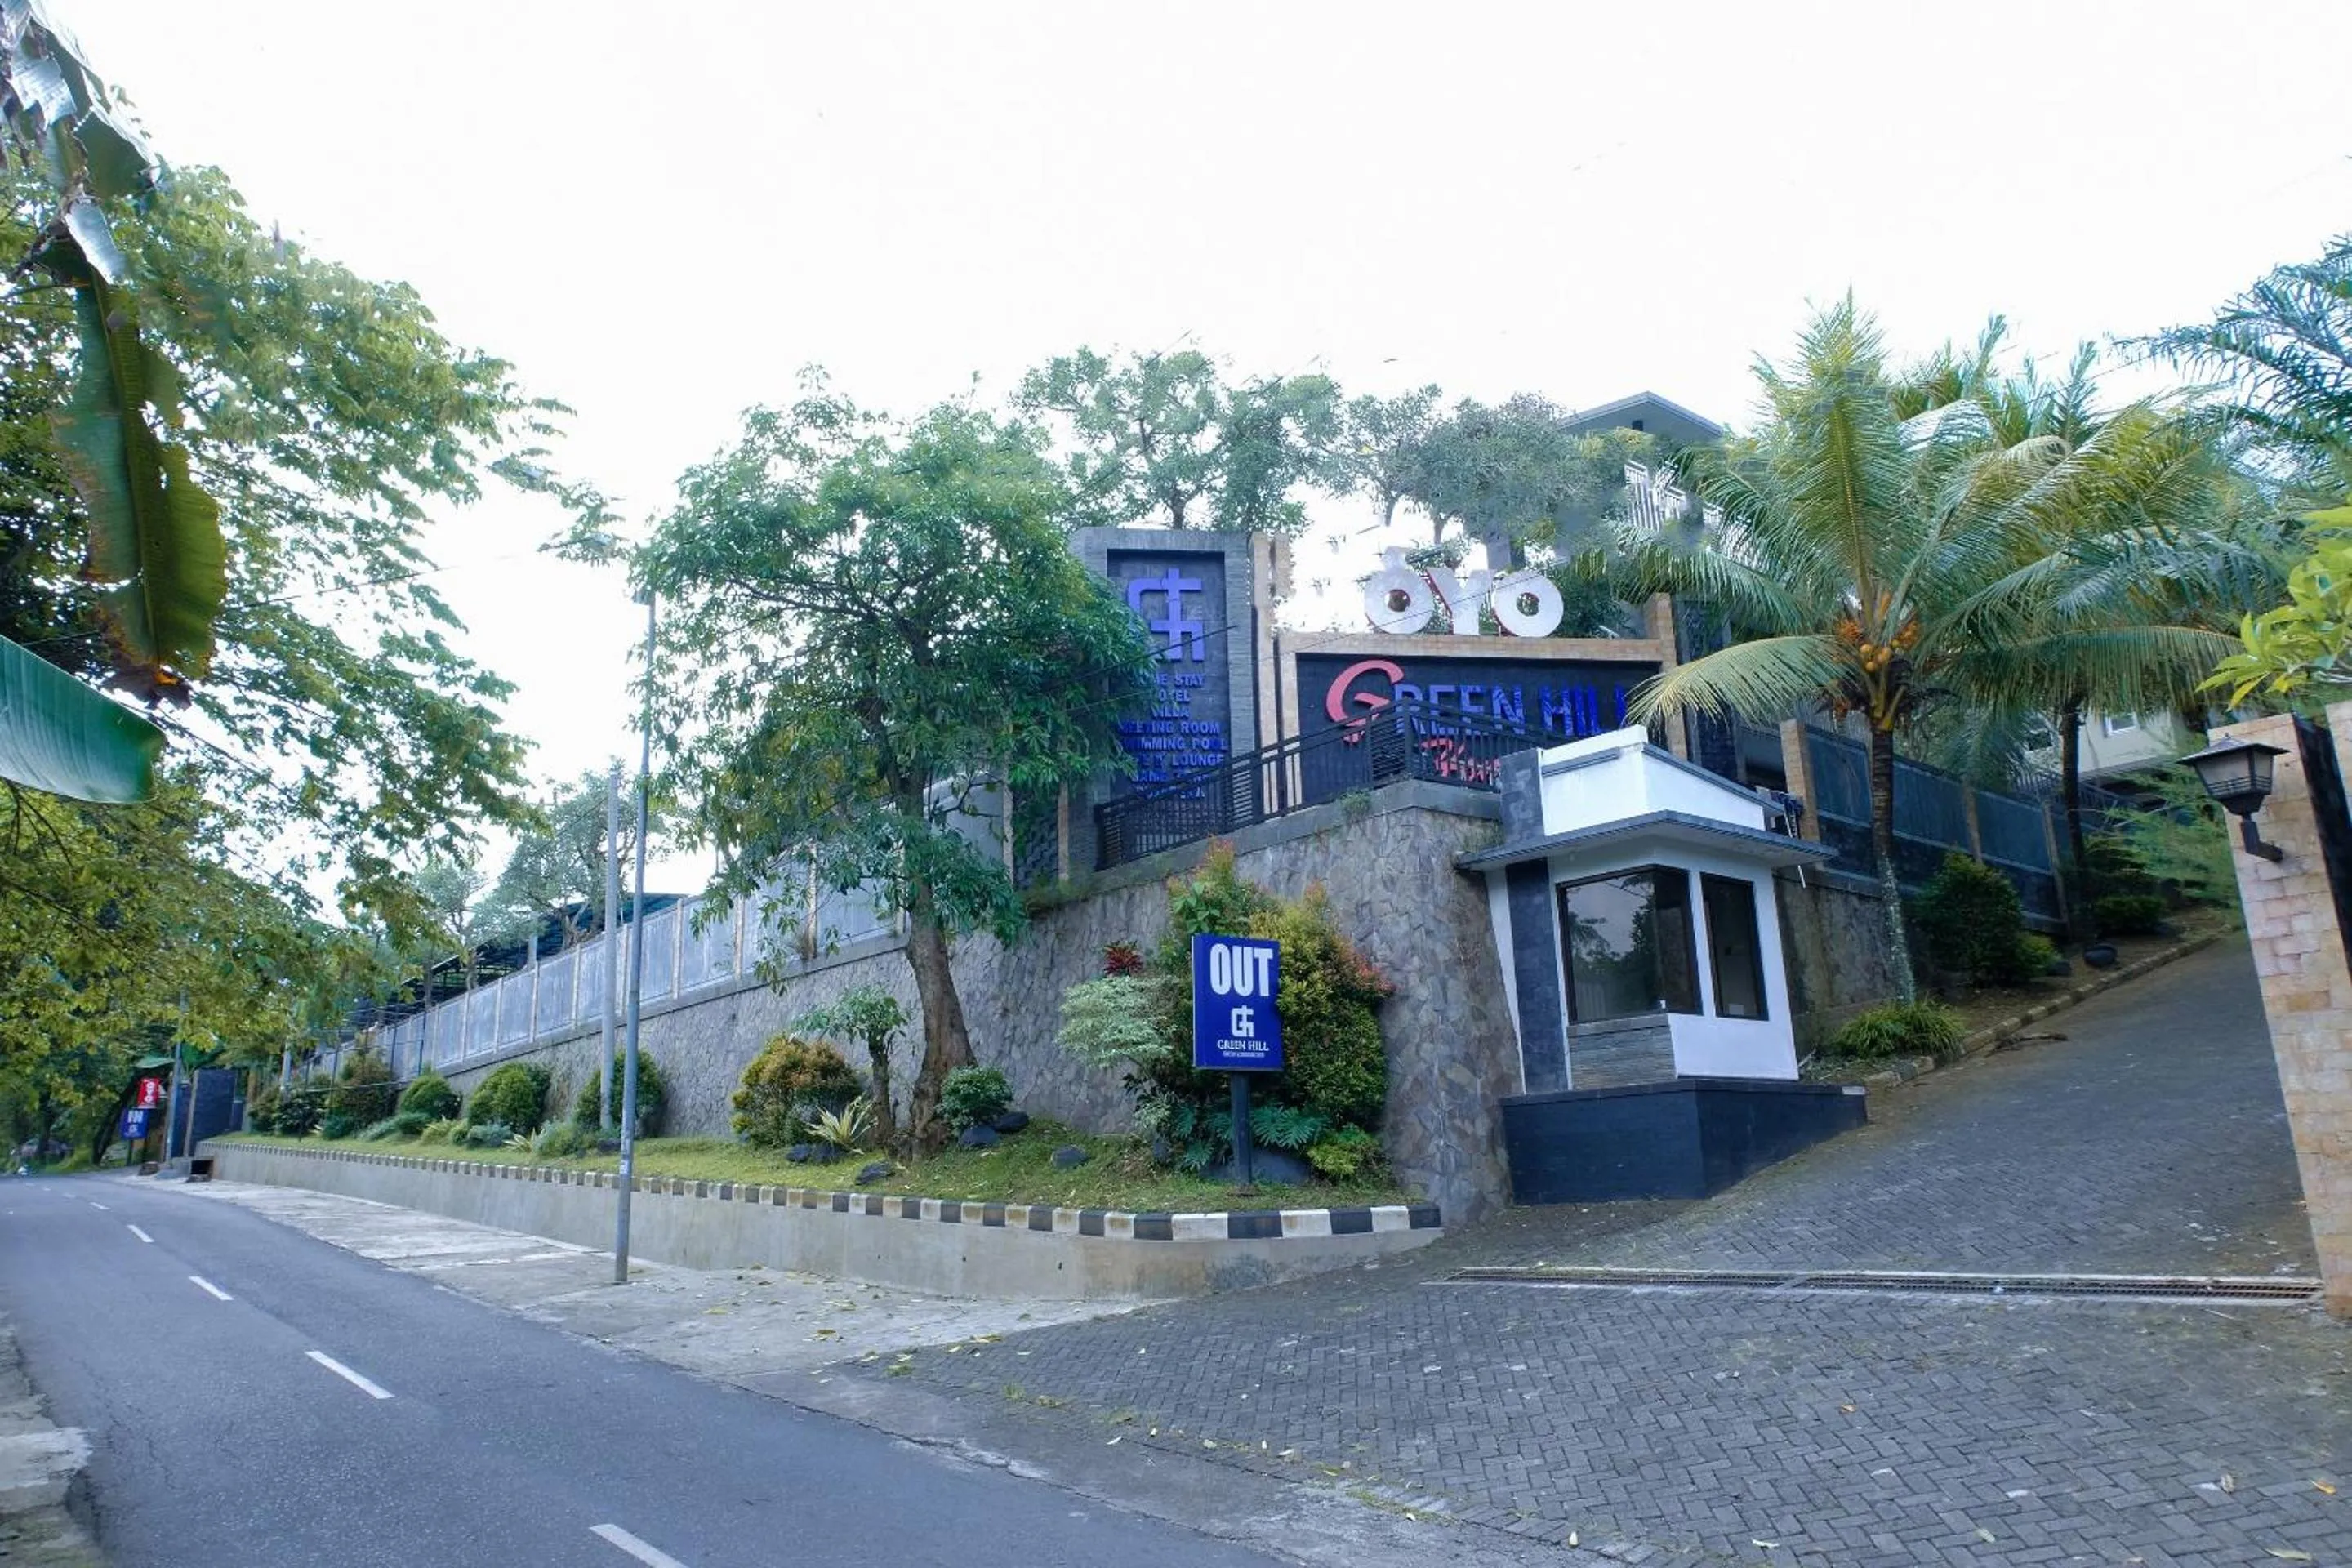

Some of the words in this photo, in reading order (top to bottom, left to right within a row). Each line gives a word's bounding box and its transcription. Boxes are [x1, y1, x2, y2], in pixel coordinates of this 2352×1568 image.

[1365, 569, 1564, 637] OYO
[1174, 673, 1205, 686] STAY
[1180, 721, 1220, 734] ROOM
[1209, 943, 1273, 996] OUT
[1217, 1039, 1246, 1050] GREEN
[1248, 1040, 1270, 1052] HILL
